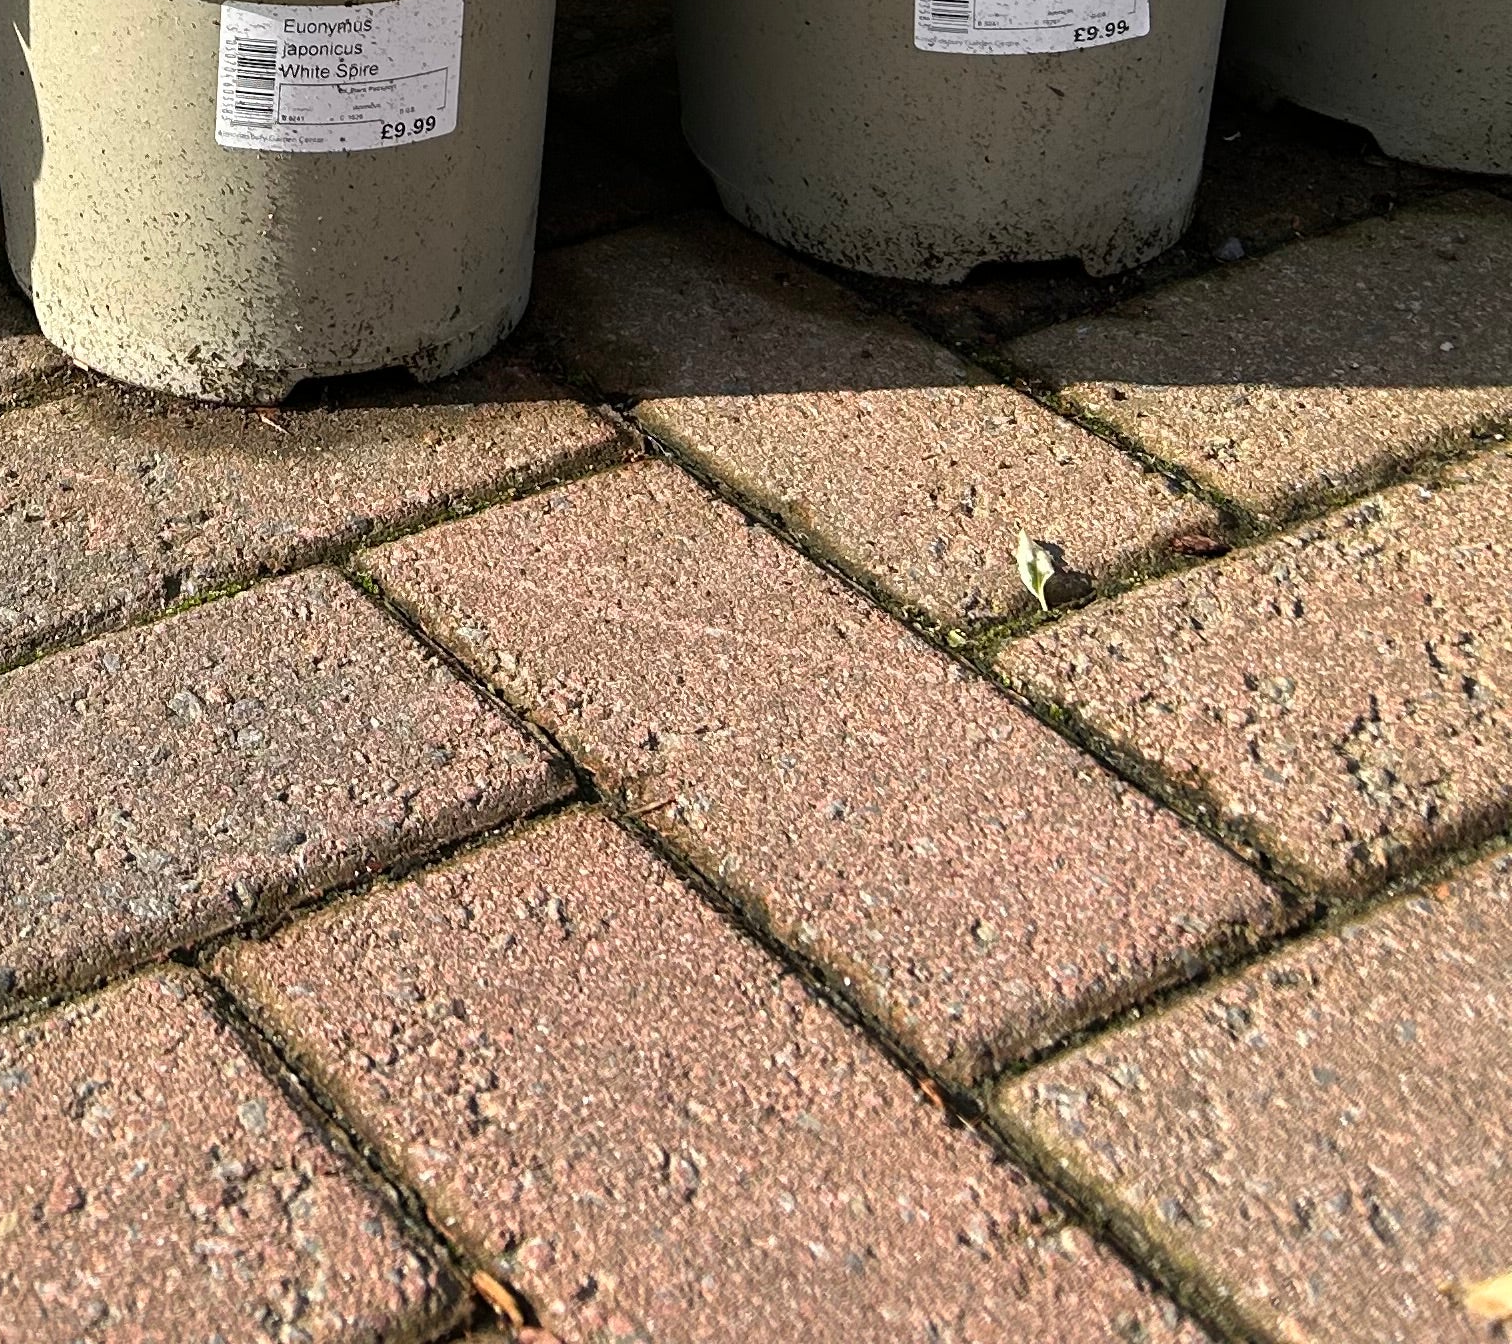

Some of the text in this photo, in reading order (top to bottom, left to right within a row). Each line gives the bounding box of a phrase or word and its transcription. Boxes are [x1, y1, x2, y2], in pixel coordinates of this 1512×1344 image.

[283, 18, 372, 36] Euonymus
[1073, 20, 1129, 42] £9.99
[282, 42, 363, 58] japonicus
[280, 62, 379, 81] White Spire
[381, 115, 436, 140] £9.99
